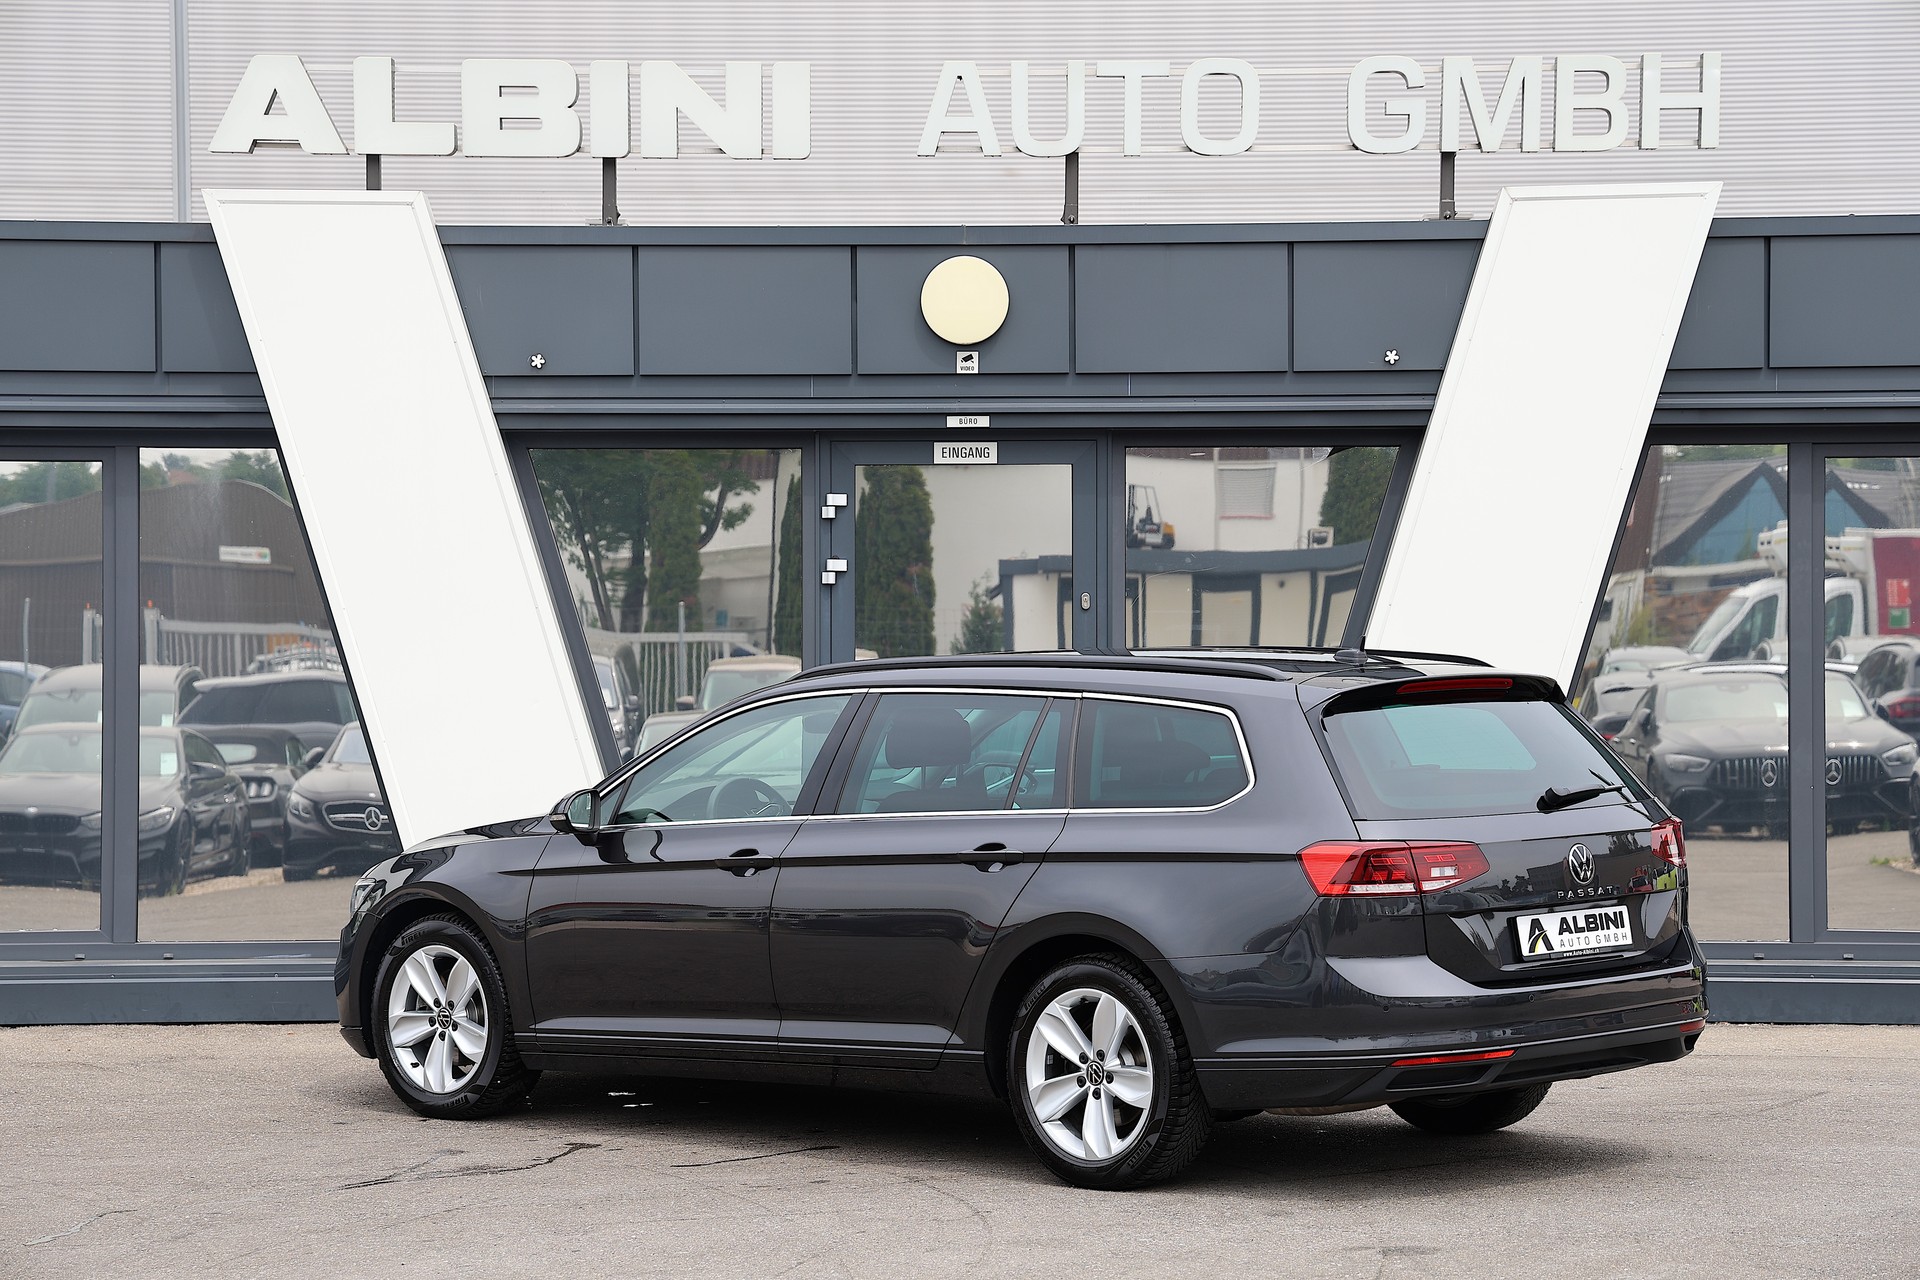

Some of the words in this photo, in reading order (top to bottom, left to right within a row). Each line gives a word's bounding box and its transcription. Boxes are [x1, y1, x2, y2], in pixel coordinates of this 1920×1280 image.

[208, 54, 812, 160] ALBINI
[916, 57, 1262, 158] AUTO
[1346, 52, 1722, 154] GMBH
[958, 416, 978, 425] BÜRO
[941, 446, 990, 459] EINGANG
[1557, 885, 1613, 899] PASSAT
[1558, 910, 1626, 936] ALBINI
[1559, 935, 1591, 949] AUTO
[1595, 932, 1628, 944] GMBH
